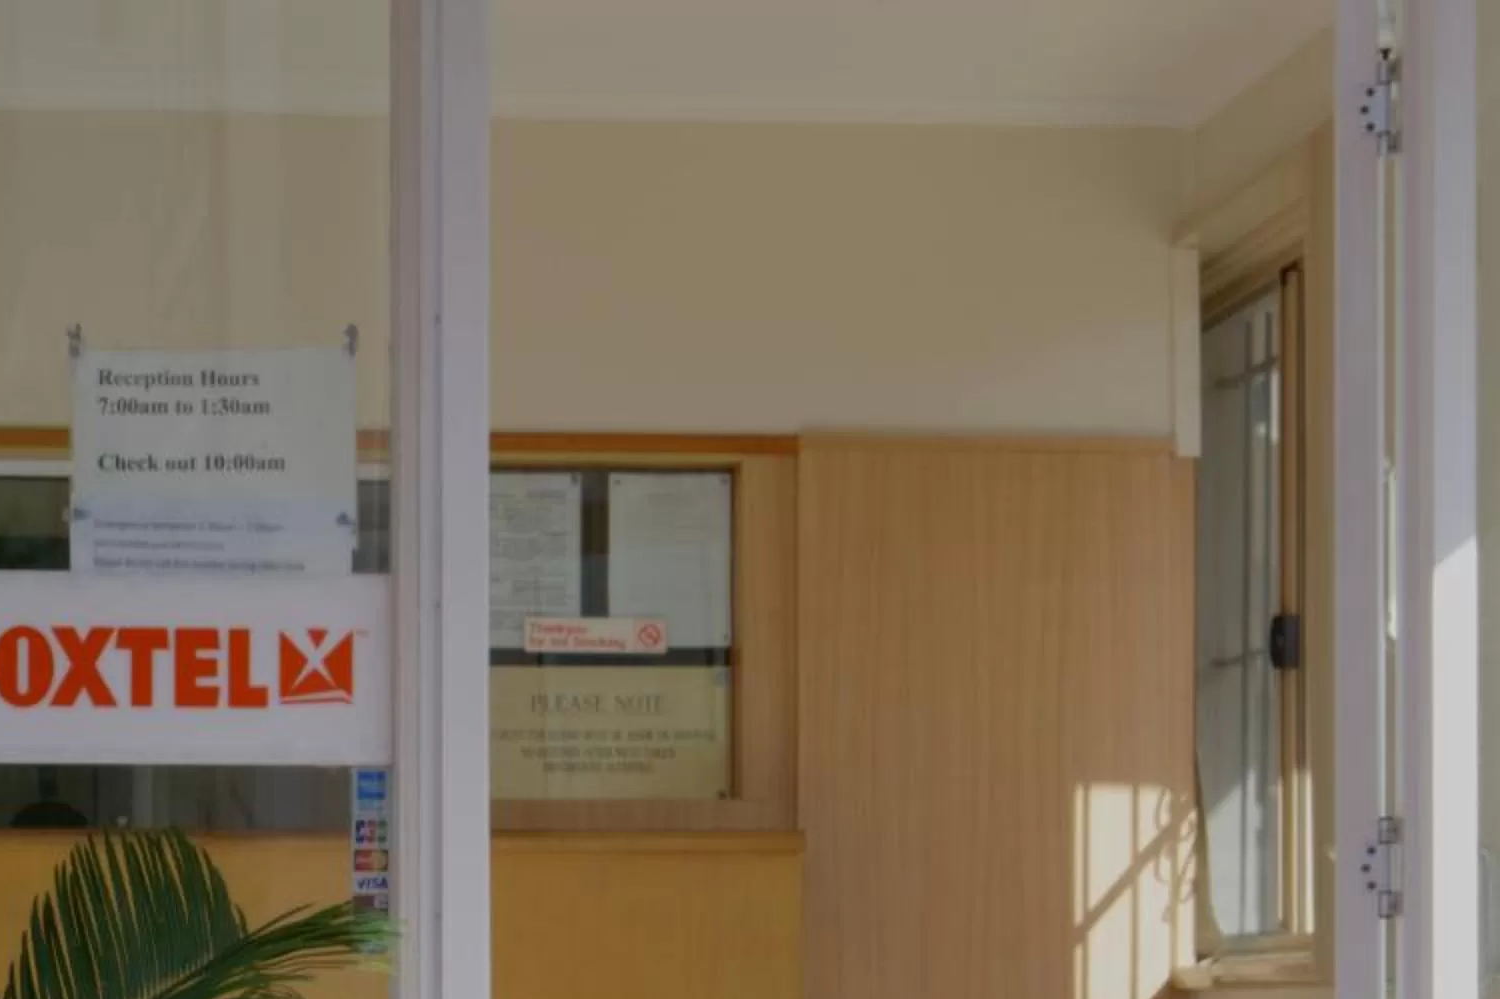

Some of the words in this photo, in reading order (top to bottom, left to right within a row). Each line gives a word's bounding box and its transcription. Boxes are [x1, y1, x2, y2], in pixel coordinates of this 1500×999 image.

[97, 368, 194, 389] Reception
[199, 369, 260, 388] Hours
[97, 397, 170, 416] 7:00am
[175, 398, 194, 416] to
[200, 397, 271, 416] 1:30am
[97, 453, 159, 473] Check
[164, 455, 197, 473] out
[203, 453, 286, 473] 10:00am
